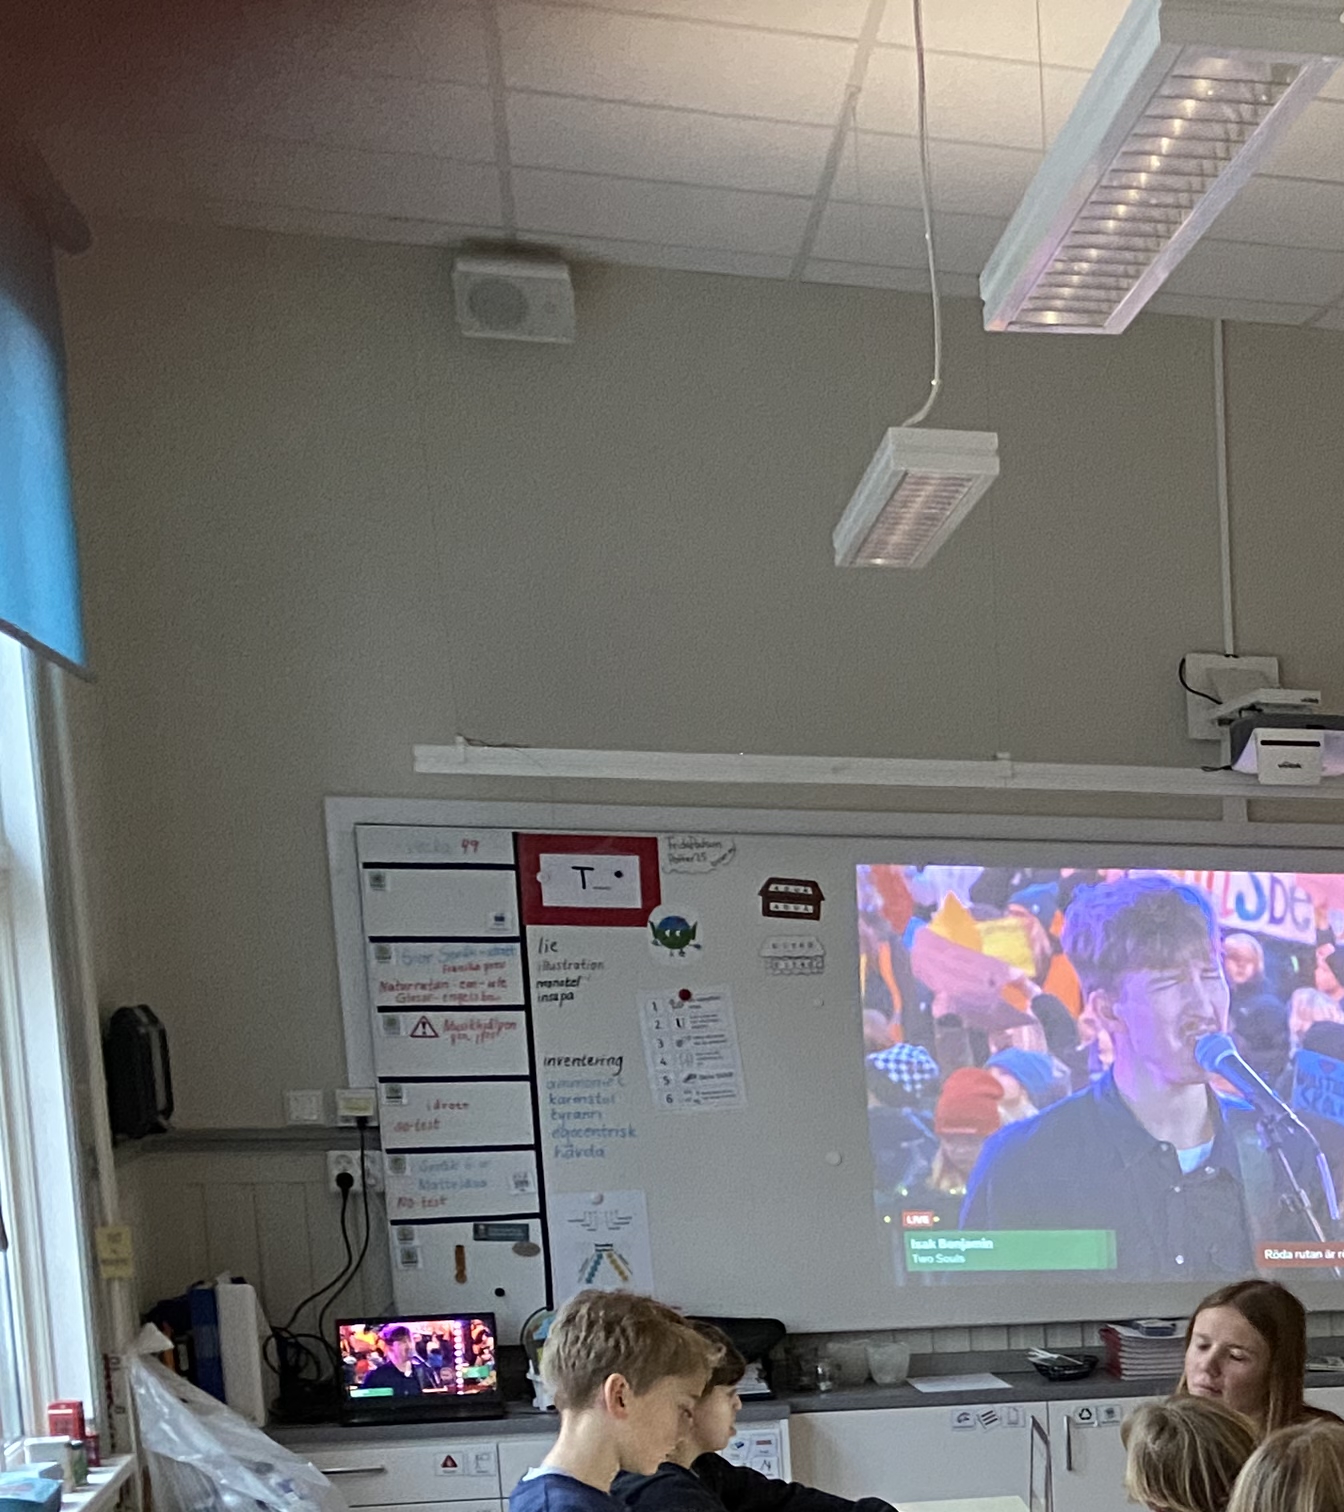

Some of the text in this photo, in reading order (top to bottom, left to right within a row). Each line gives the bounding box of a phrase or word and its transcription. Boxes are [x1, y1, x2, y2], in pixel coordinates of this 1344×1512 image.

[538, 957, 605, 972] illustration
[652, 1001, 658, 1012] 1
[655, 1020, 662, 1030] 2
[657, 1038, 665, 1049] 3
[543, 1055, 625, 1077] inventering
[660, 1057, 667, 1066] 4
[662, 1075, 670, 1086] 5
[665, 1093, 673, 1104] 6
[906, 1214, 931, 1226] LIVE
[909, 1237, 994, 1252] Isak Benjamin
[912, 1253, 966, 1264] Two Souls
[1264, 1248, 1294, 1260] Röda
[1294, 1249, 1324, 1260] rutan
[1324, 1248, 1337, 1260] är
